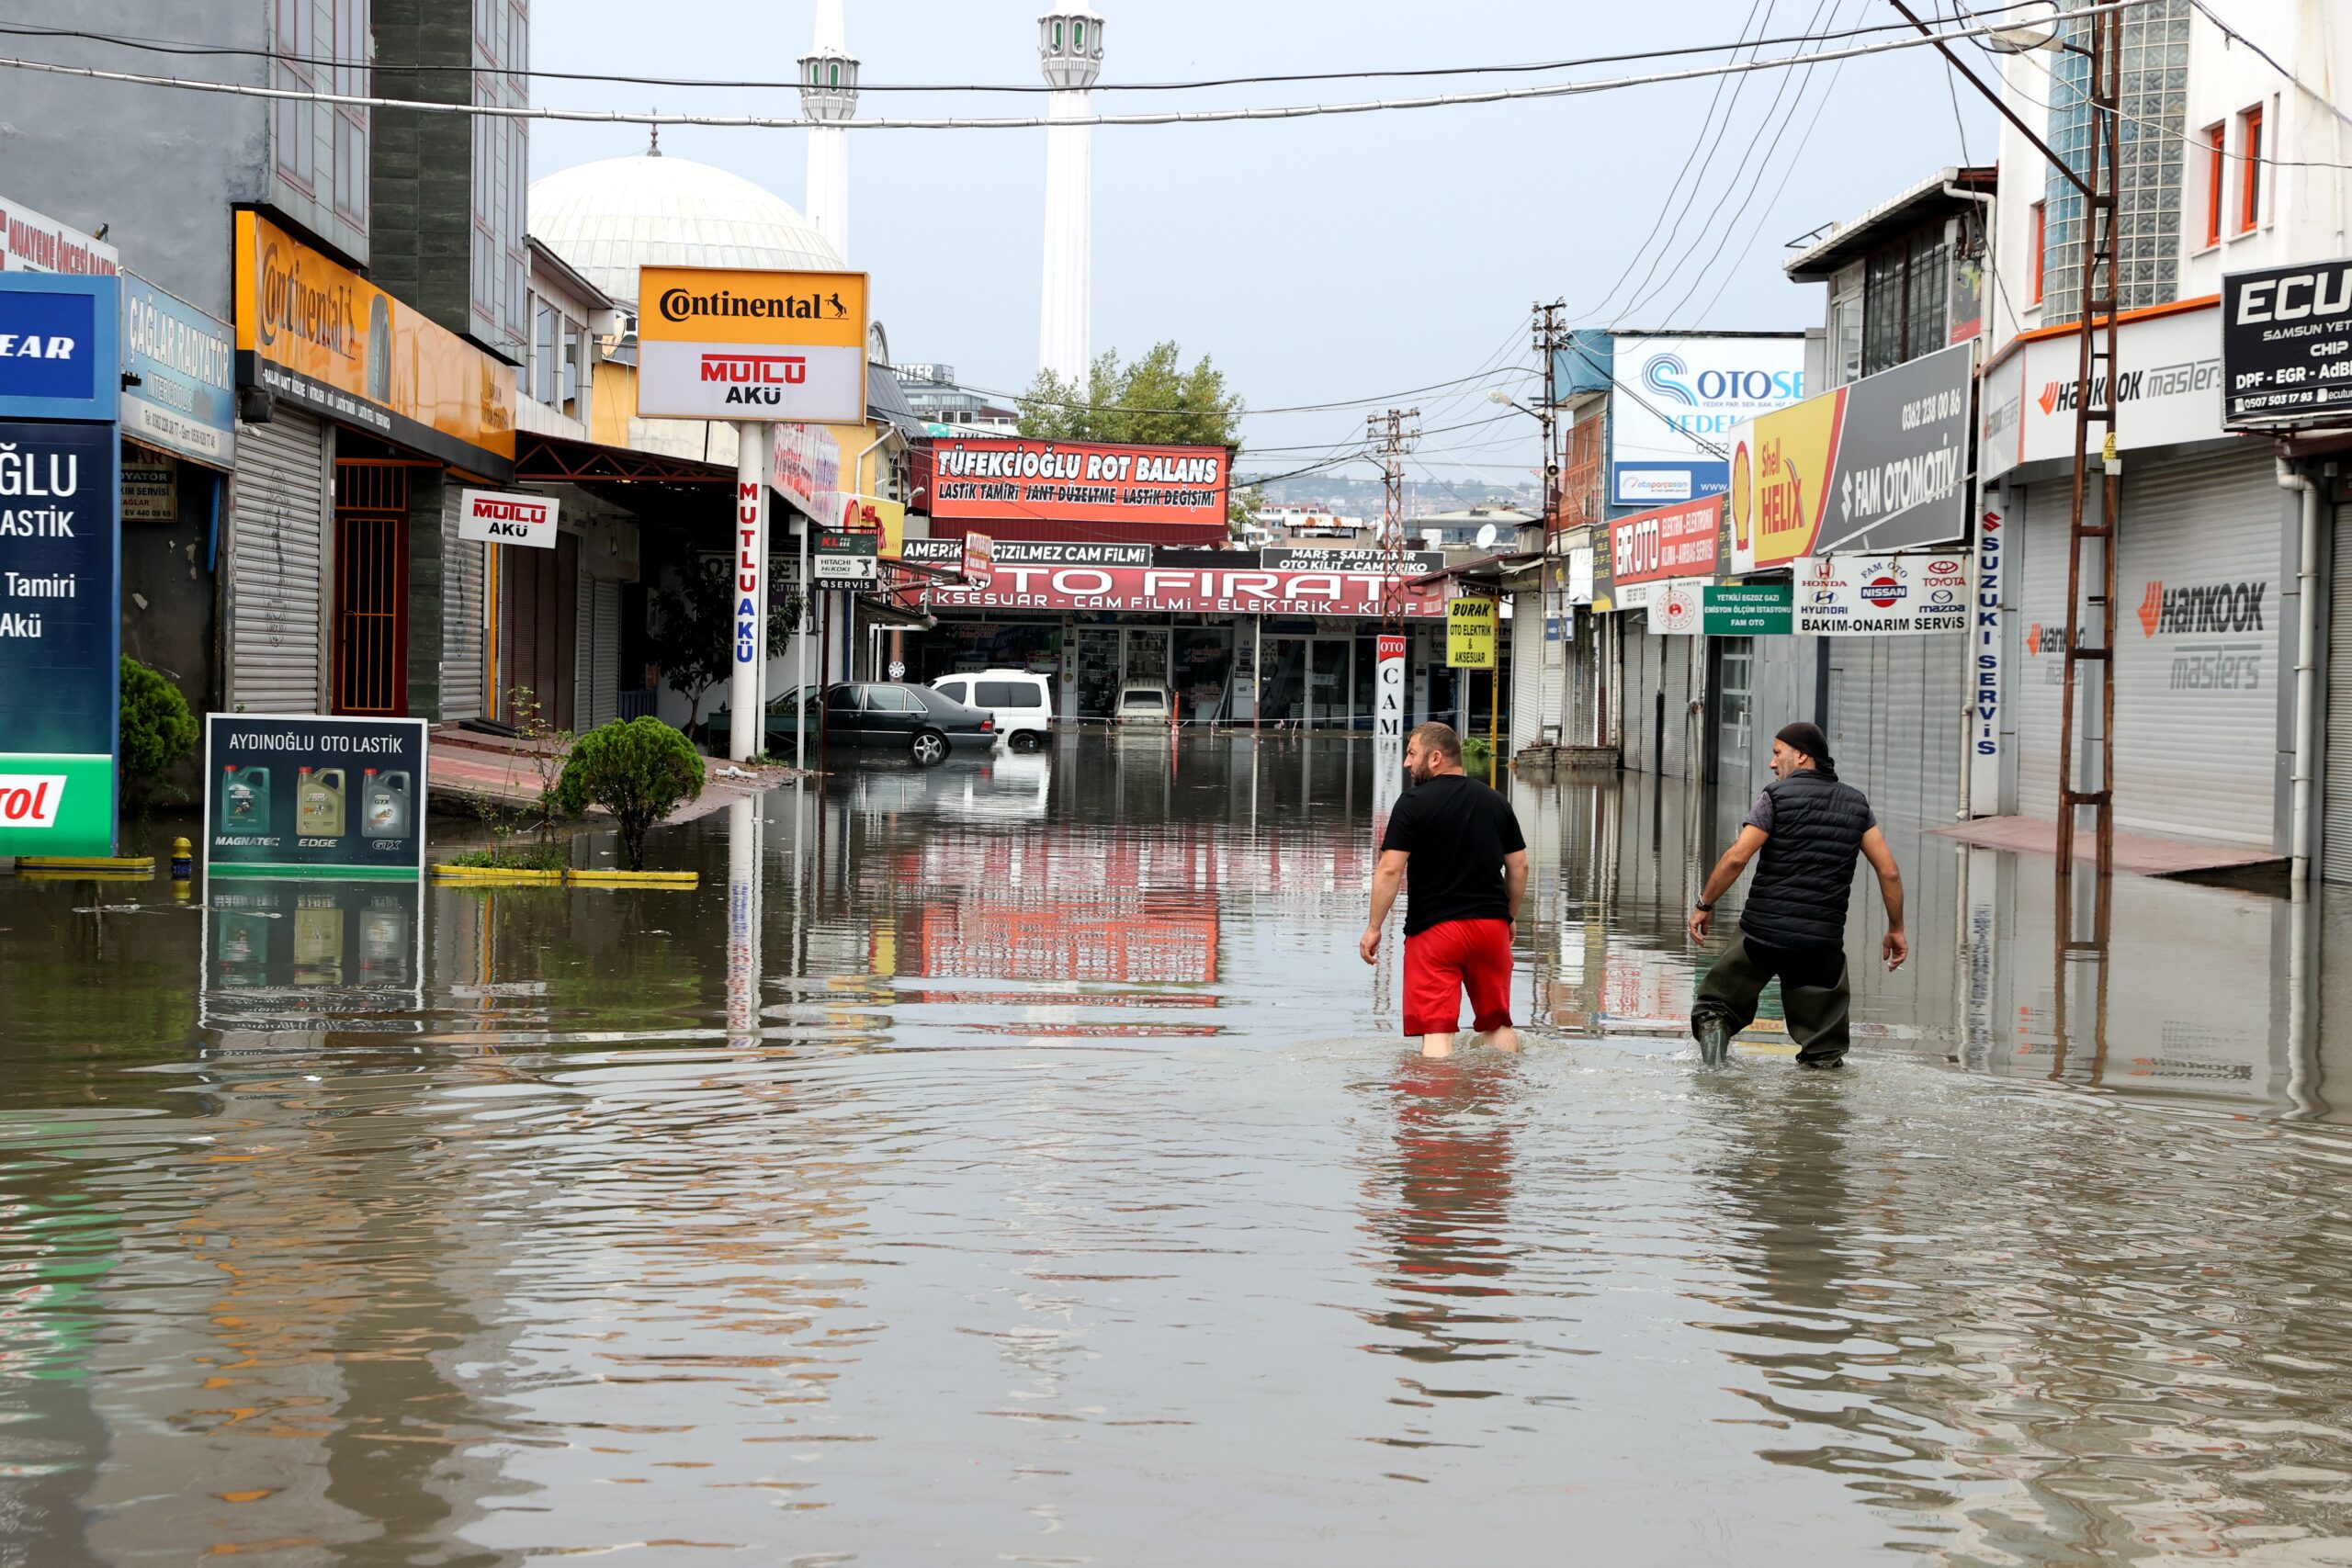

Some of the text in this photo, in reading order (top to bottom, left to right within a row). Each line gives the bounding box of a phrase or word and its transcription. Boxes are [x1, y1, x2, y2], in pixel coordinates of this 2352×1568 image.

[8, 217, 54, 270] MUAYENE
[261, 242, 344, 355] Continental
[660, 288, 822, 322] Continental
[130, 290, 175, 369] ÇAĞLAR
[2263, 323, 2323, 341] SAMSUN
[2310, 341, 2349, 356] CHIP
[701, 354, 806, 384] MUTLU
[2236, 371, 2265, 389] DPF
[2276, 367, 2306, 384] EGR
[725, 386, 781, 404] AKÜ
[2245, 396, 2267, 409] 0507
[2267, 394, 2287, 406] 503
[2288, 393, 2300, 403] 17
[2300, 391, 2313, 402] 93
[1902, 401, 1920, 432] 0362
[1921, 397, 1936, 426] 238
[1938, 395, 1948, 422] 00
[1949, 388, 1961, 418] 86
[1761, 436, 1781, 479] Shell
[0, 443, 76, 497] ĞLU
[1085, 455, 1132, 480] ROT
[1135, 456, 1218, 484] BALANS
[1855, 432, 1959, 518] FAM OTOMOTİV
[1024, 483, 1057, 502] JANT
[1057, 481, 1116, 504] DÜZELTME
[472, 499, 547, 525] MUTLU
[1760, 478, 1804, 536] HELIX
[0, 504, 75, 537] ASTİK
[489, 522, 528, 537] AKÜ
[821, 537, 839, 547] KL
[1066, 546, 1102, 560] CAM
[1291, 549, 1330, 560] MARŞ
[1339, 550, 1373, 561] ŞARJ
[736, 483, 758, 663] MUTLU AKÜ
[1279, 559, 1308, 570] OTO
[1353, 561, 1384, 571] CAM
[1860, 561, 1908, 579] FAM OTO
[5, 571, 75, 598] Tamiri
[831, 580, 870, 589] SERVİS
[931, 566, 1113, 595] OTO
[1144, 570, 1403, 601] FIRAT
[1922, 577, 1966, 587] TOYOTA
[1978, 536, 2000, 646] SUZUKI
[919, 591, 1048, 607] AKSESUAR
[1073, 594, 1122, 608] CAM
[1862, 587, 1906, 598] NISSAN
[1452, 603, 1491, 617] BURAK
[1733, 604, 1756, 615] ÖLÇÜM
[1800, 605, 1849, 615] HYUNDAI
[0, 613, 41, 637] Akü
[1450, 625, 1462, 636] OTO
[1463, 622, 1492, 637] ELEKTRİK
[1802, 618, 1910, 632] BAKIM-ONARIM
[1454, 651, 1486, 663] AKSESUAR
[1379, 641, 1405, 736] OTO CAM
[229, 731, 403, 753] AYDINOĞLU OTO LASTİK
[215, 836, 280, 847] MAGNATEC
[298, 839, 338, 848] EDGE
[372, 840, 402, 852] GTX
